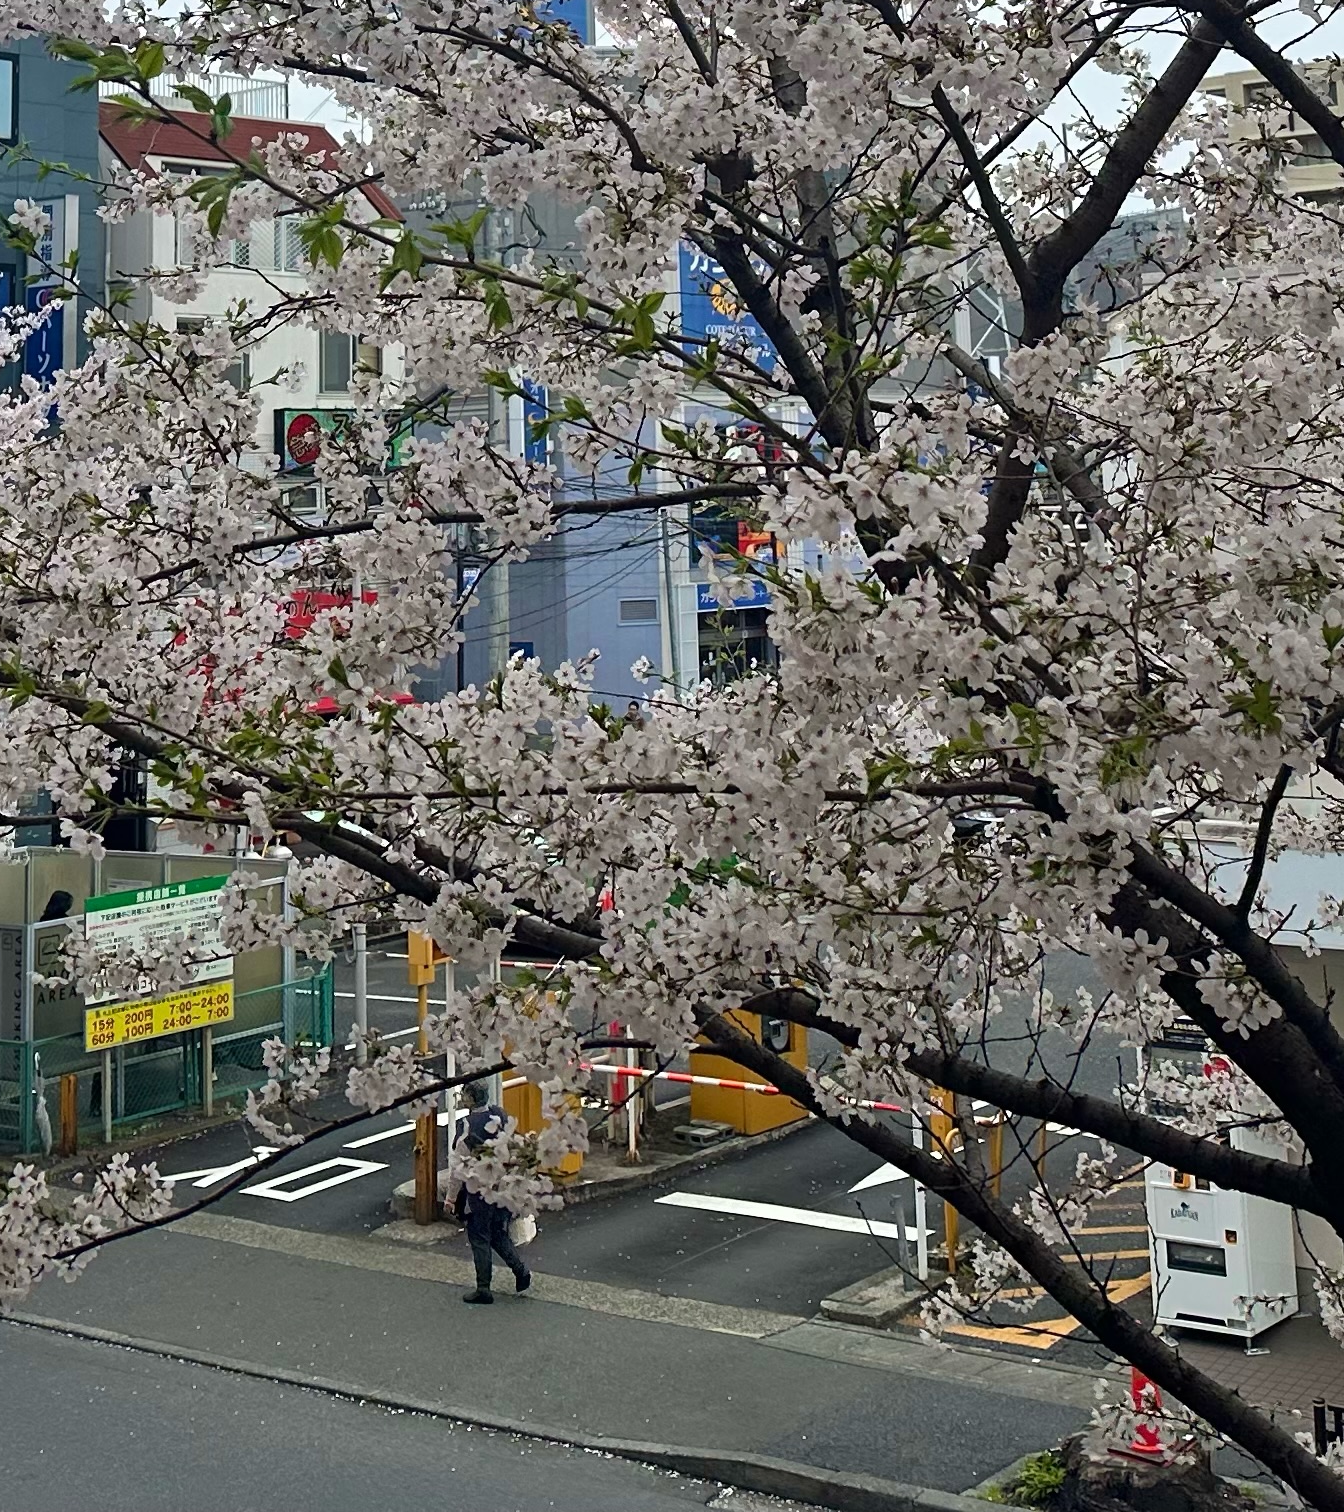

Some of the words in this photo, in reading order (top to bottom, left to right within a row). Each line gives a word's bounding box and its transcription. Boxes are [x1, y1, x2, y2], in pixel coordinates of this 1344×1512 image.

[37, 985, 78, 1006] AREA
[92, 1017, 115, 1033] 15分
[124, 1009, 154, 1026] 200円
[91, 1031, 115, 1046] 60分
[125, 1022, 154, 1039] 100円
